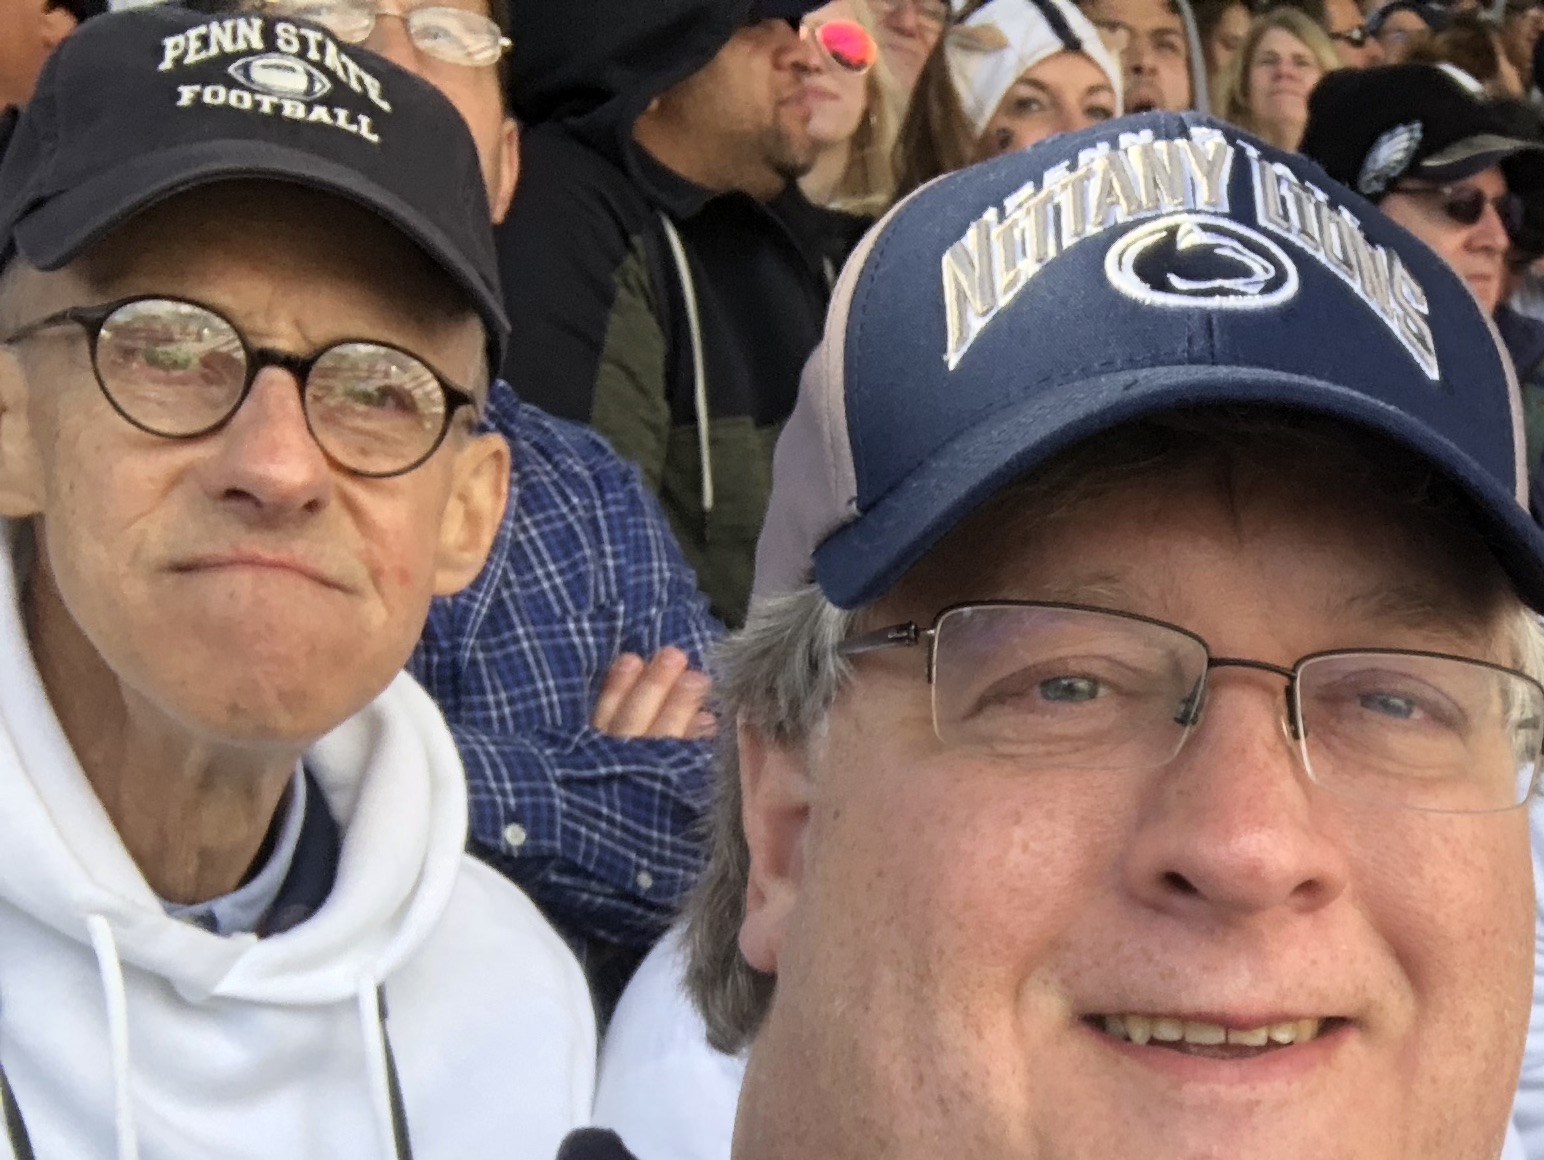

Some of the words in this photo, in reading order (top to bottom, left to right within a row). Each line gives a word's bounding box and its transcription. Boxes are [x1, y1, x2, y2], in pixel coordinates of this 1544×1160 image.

[157, 16, 265, 71] PENN
[274, 21, 393, 113] STATE
[175, 84, 381, 143] FOOTBALL
[942, 126, 1234, 371] NITTANY
[1236, 138, 1440, 381] LIONS
